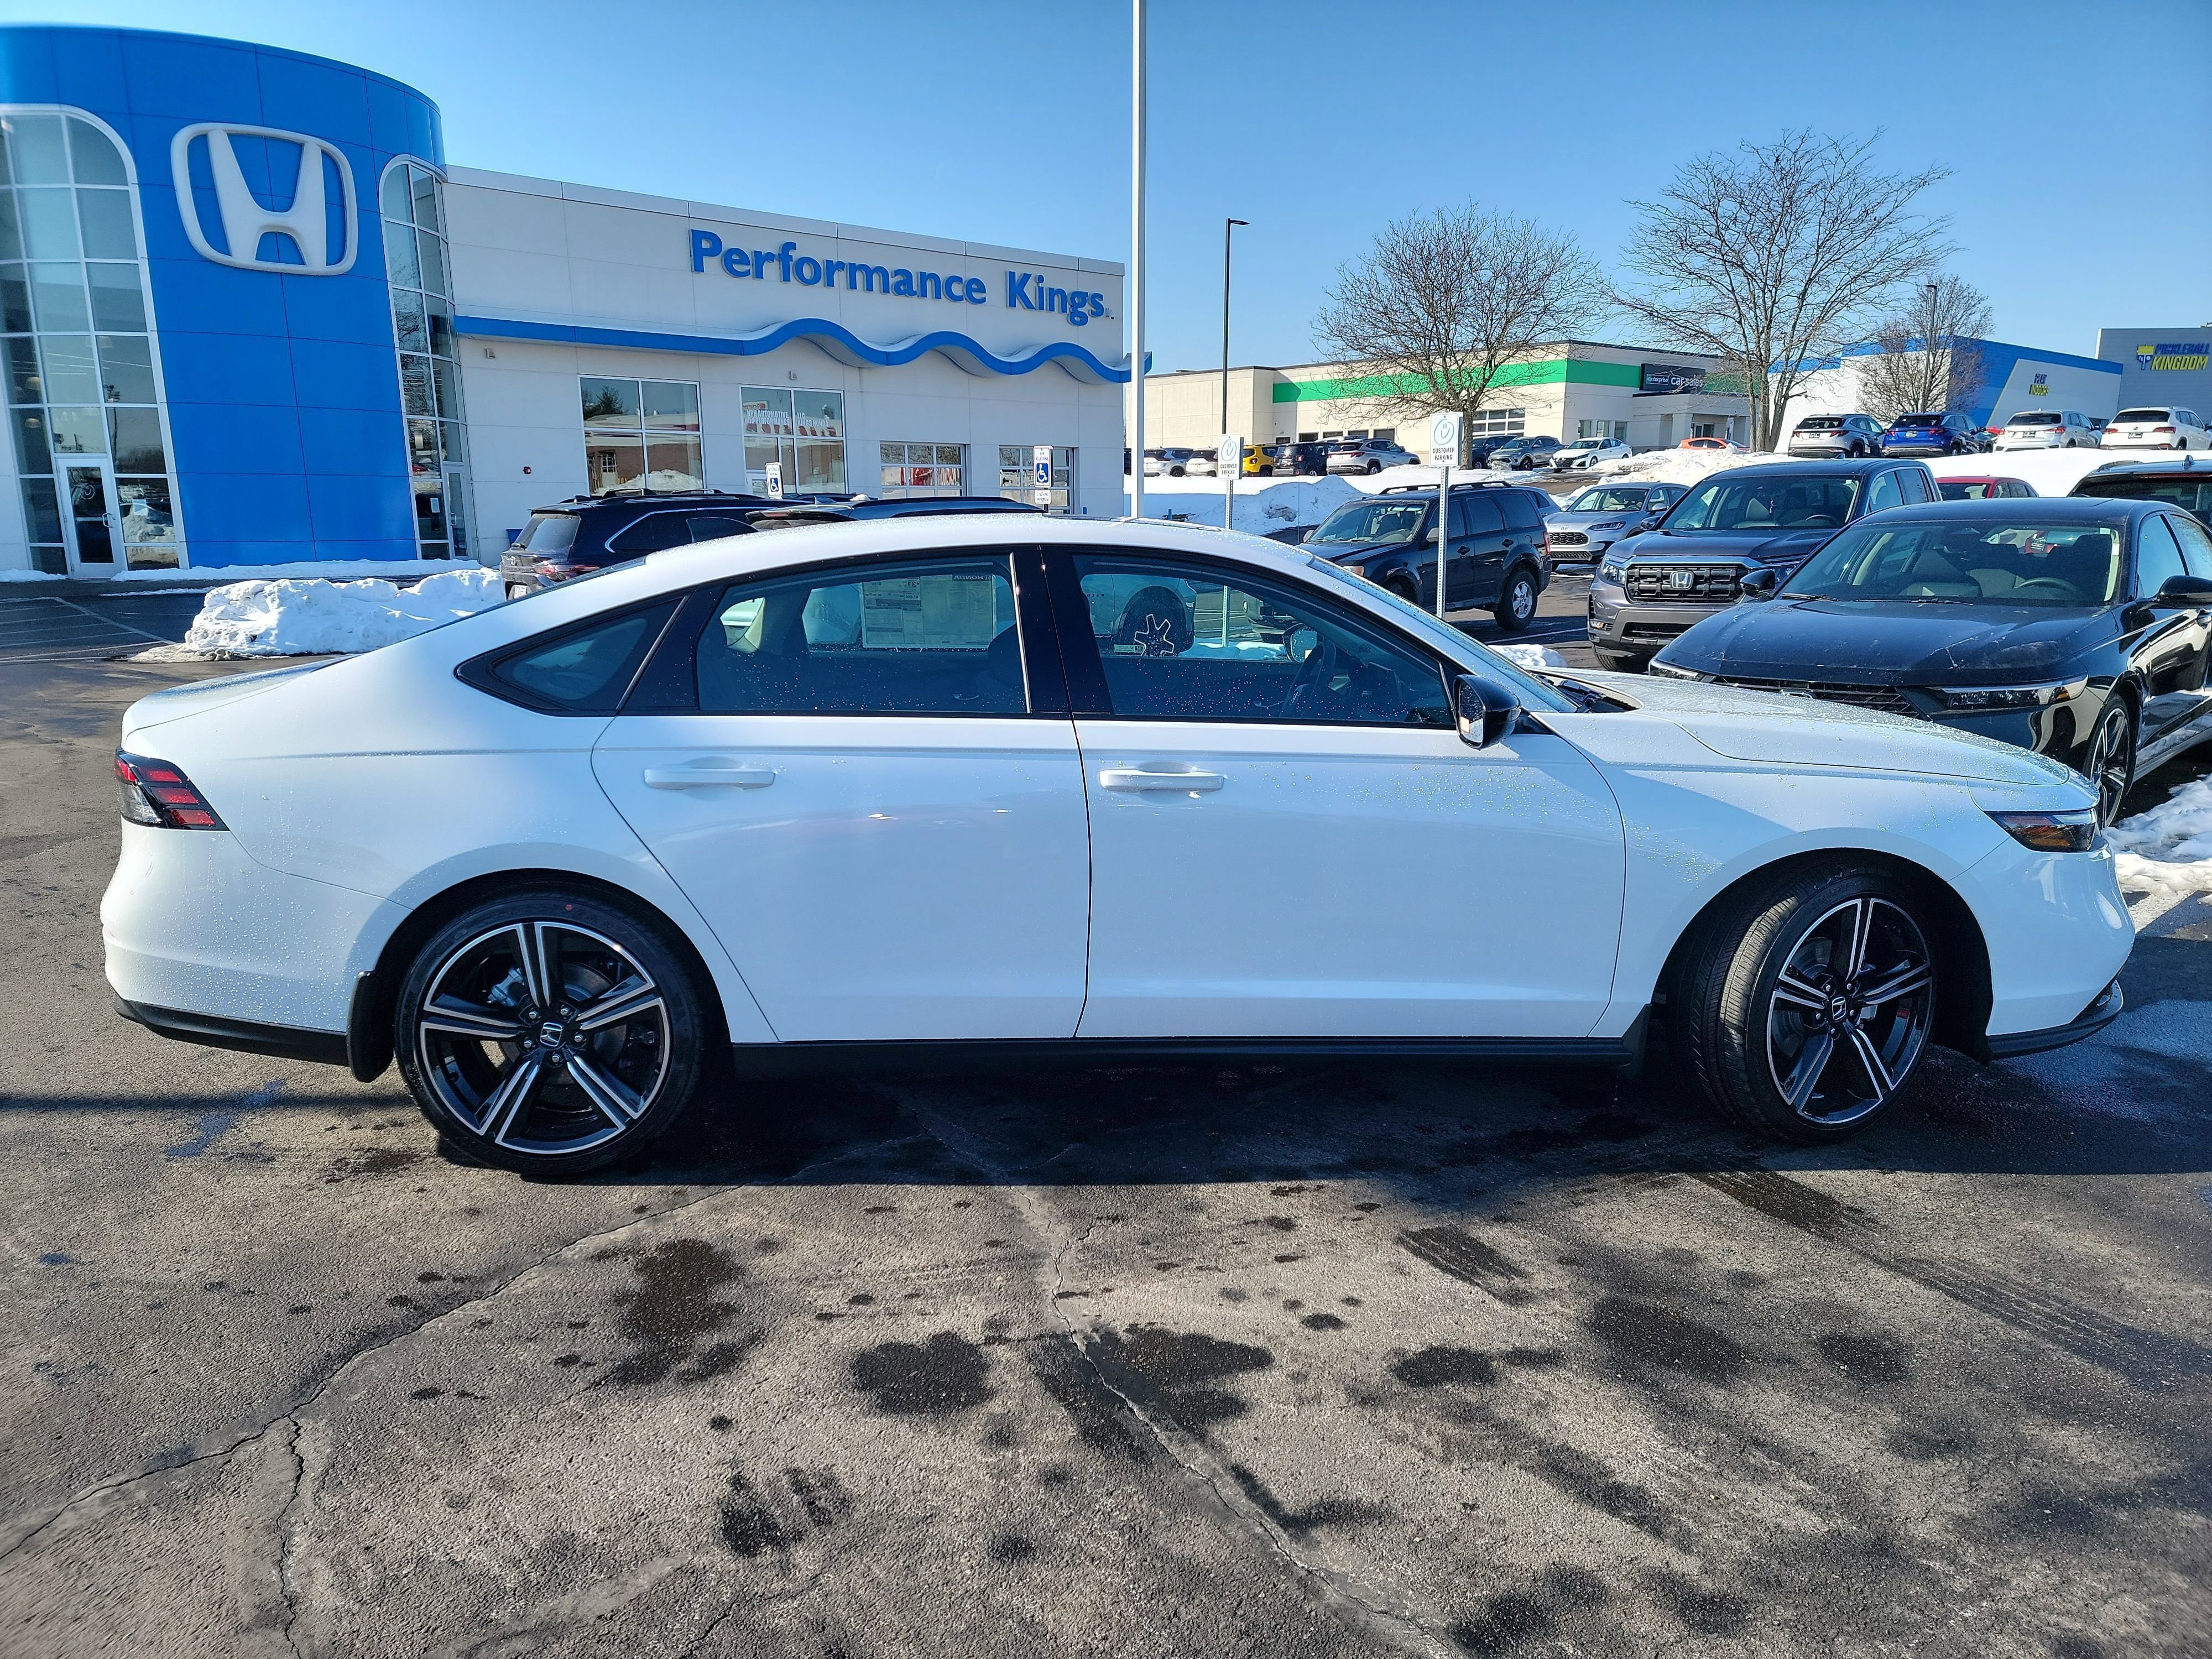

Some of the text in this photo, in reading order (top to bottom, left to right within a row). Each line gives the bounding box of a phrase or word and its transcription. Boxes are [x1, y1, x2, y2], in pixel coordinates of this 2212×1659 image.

[689, 228, 1105, 327] Performance Kings
[2151, 356, 2209, 371] KINGDOM
[1671, 377, 1684, 385] car
[758, 410, 789, 419] AUTOMOTIVE
[755, 417, 790, 425] PERFORMANCE
